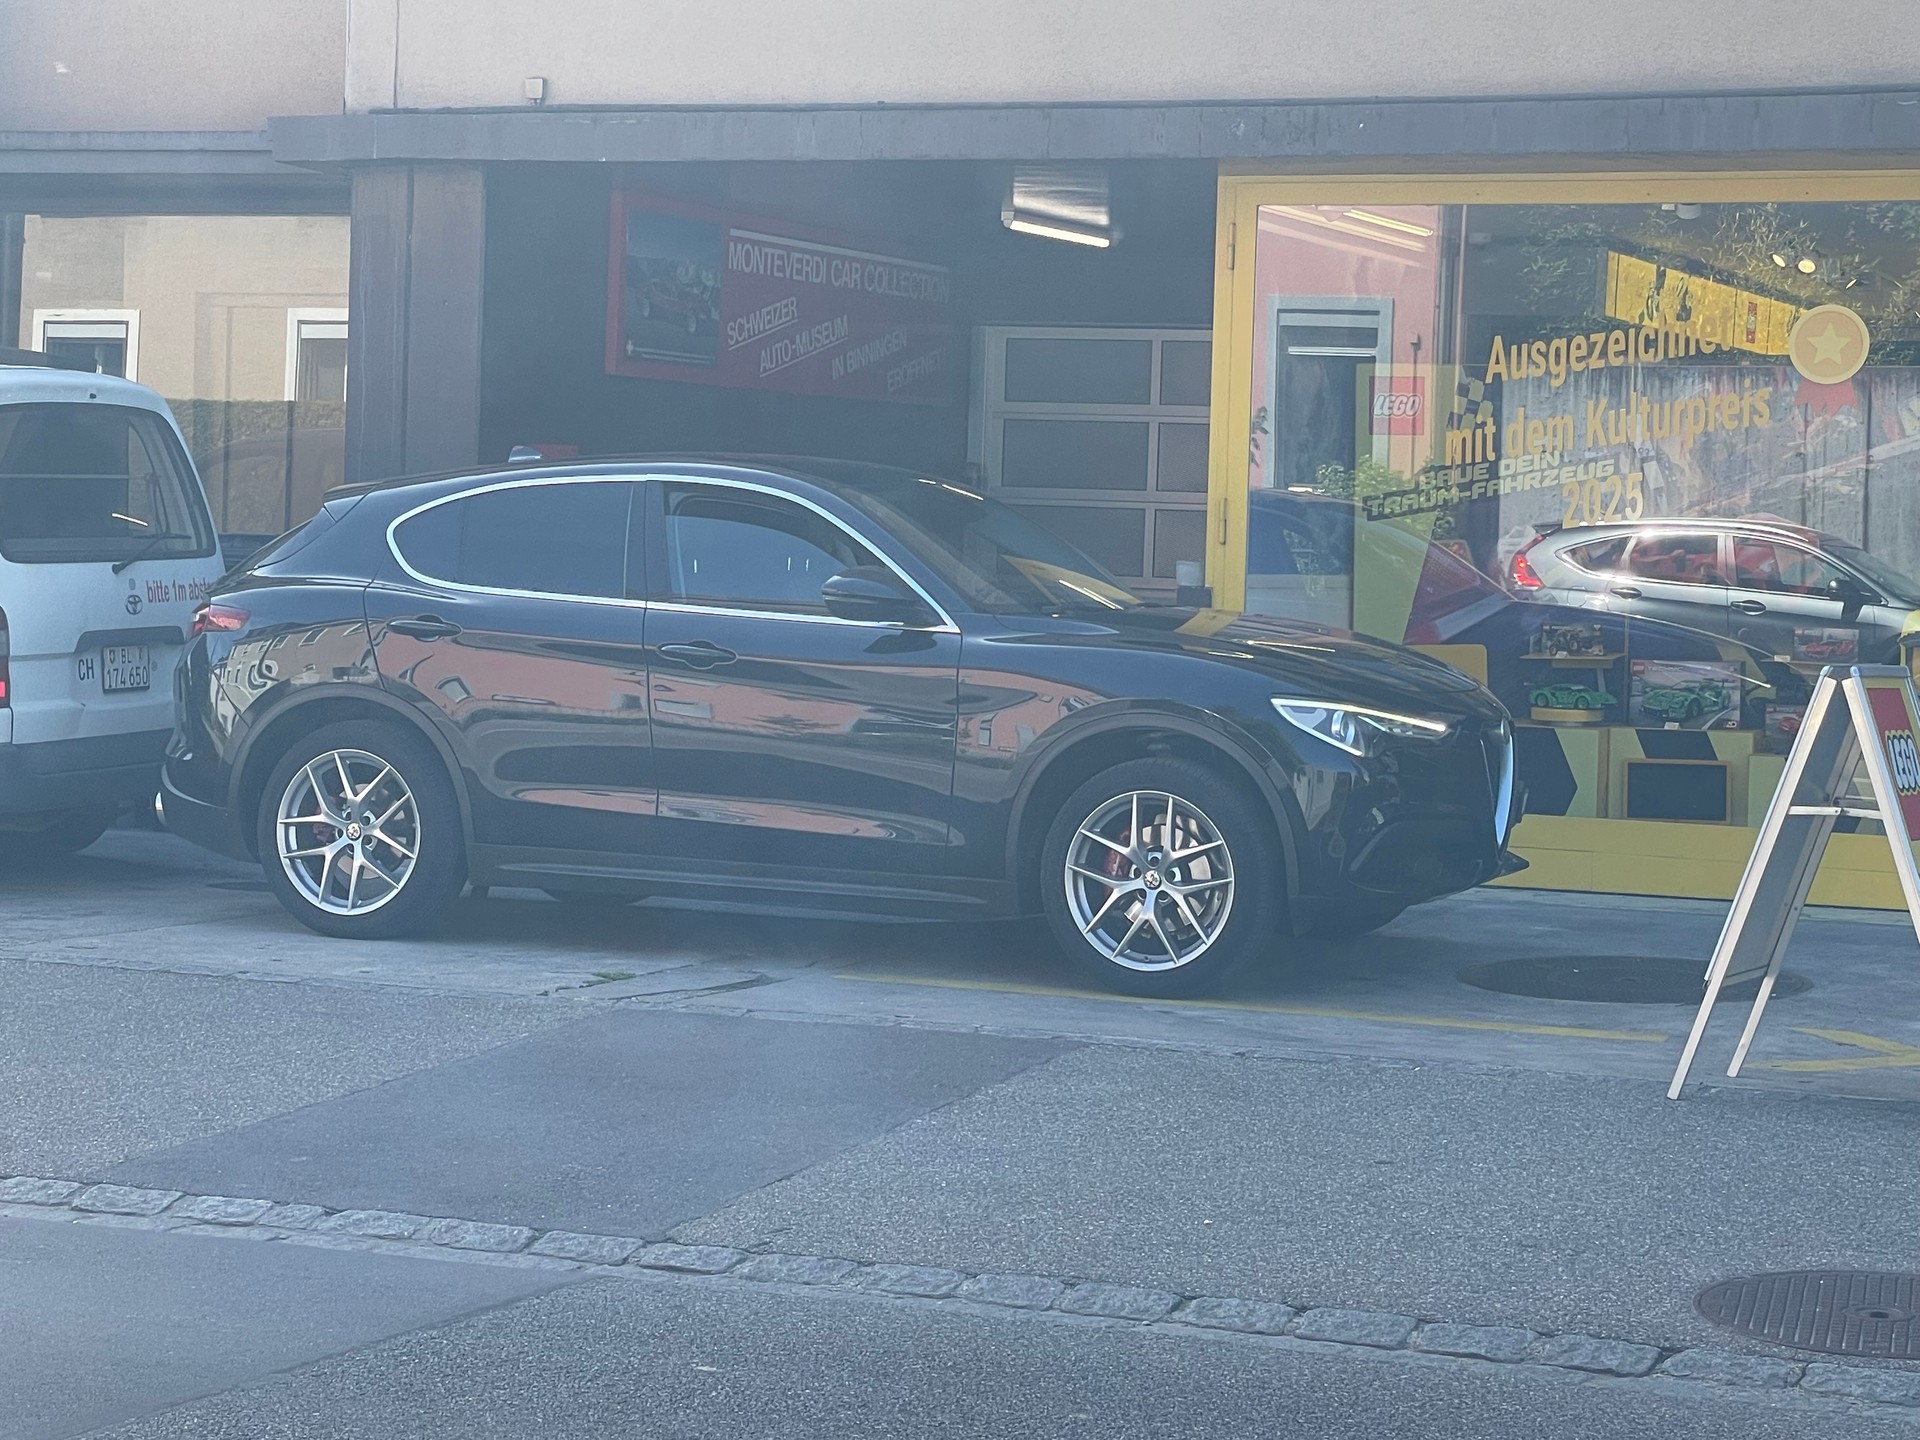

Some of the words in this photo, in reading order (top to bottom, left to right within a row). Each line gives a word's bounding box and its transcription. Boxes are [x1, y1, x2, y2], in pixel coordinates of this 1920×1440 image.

[728, 241, 827, 284] MONTEVERDI
[831, 260, 861, 289] CAR
[864, 264, 950, 303] COLLECTION
[727, 296, 798, 345] SCHWEIZER
[760, 314, 849, 372] AUTO-MUSEUM
[832, 356, 845, 380] IN
[848, 328, 908, 373] BINNINGEN
[1485, 307, 1735, 388] Ausgezeichnet
[1373, 393, 1421, 417] LEGO
[1445, 414, 1497, 466] mit
[1506, 405, 1575, 459] dem
[1586, 379, 1772, 449] Kulturpreis
[1366, 458, 1615, 517] TRAUM-FAHRZEUG
[1420, 463, 1490, 491] BAUE
[1498, 450, 1561, 476] DEIN
[1562, 472, 1643, 529] 2025
[146, 579, 170, 603] bitte
[172, 579, 187, 602] 1m
[78, 658, 95, 681] CH
[121, 648, 132, 664] BL
[1887, 736, 1920, 790] LEGO
